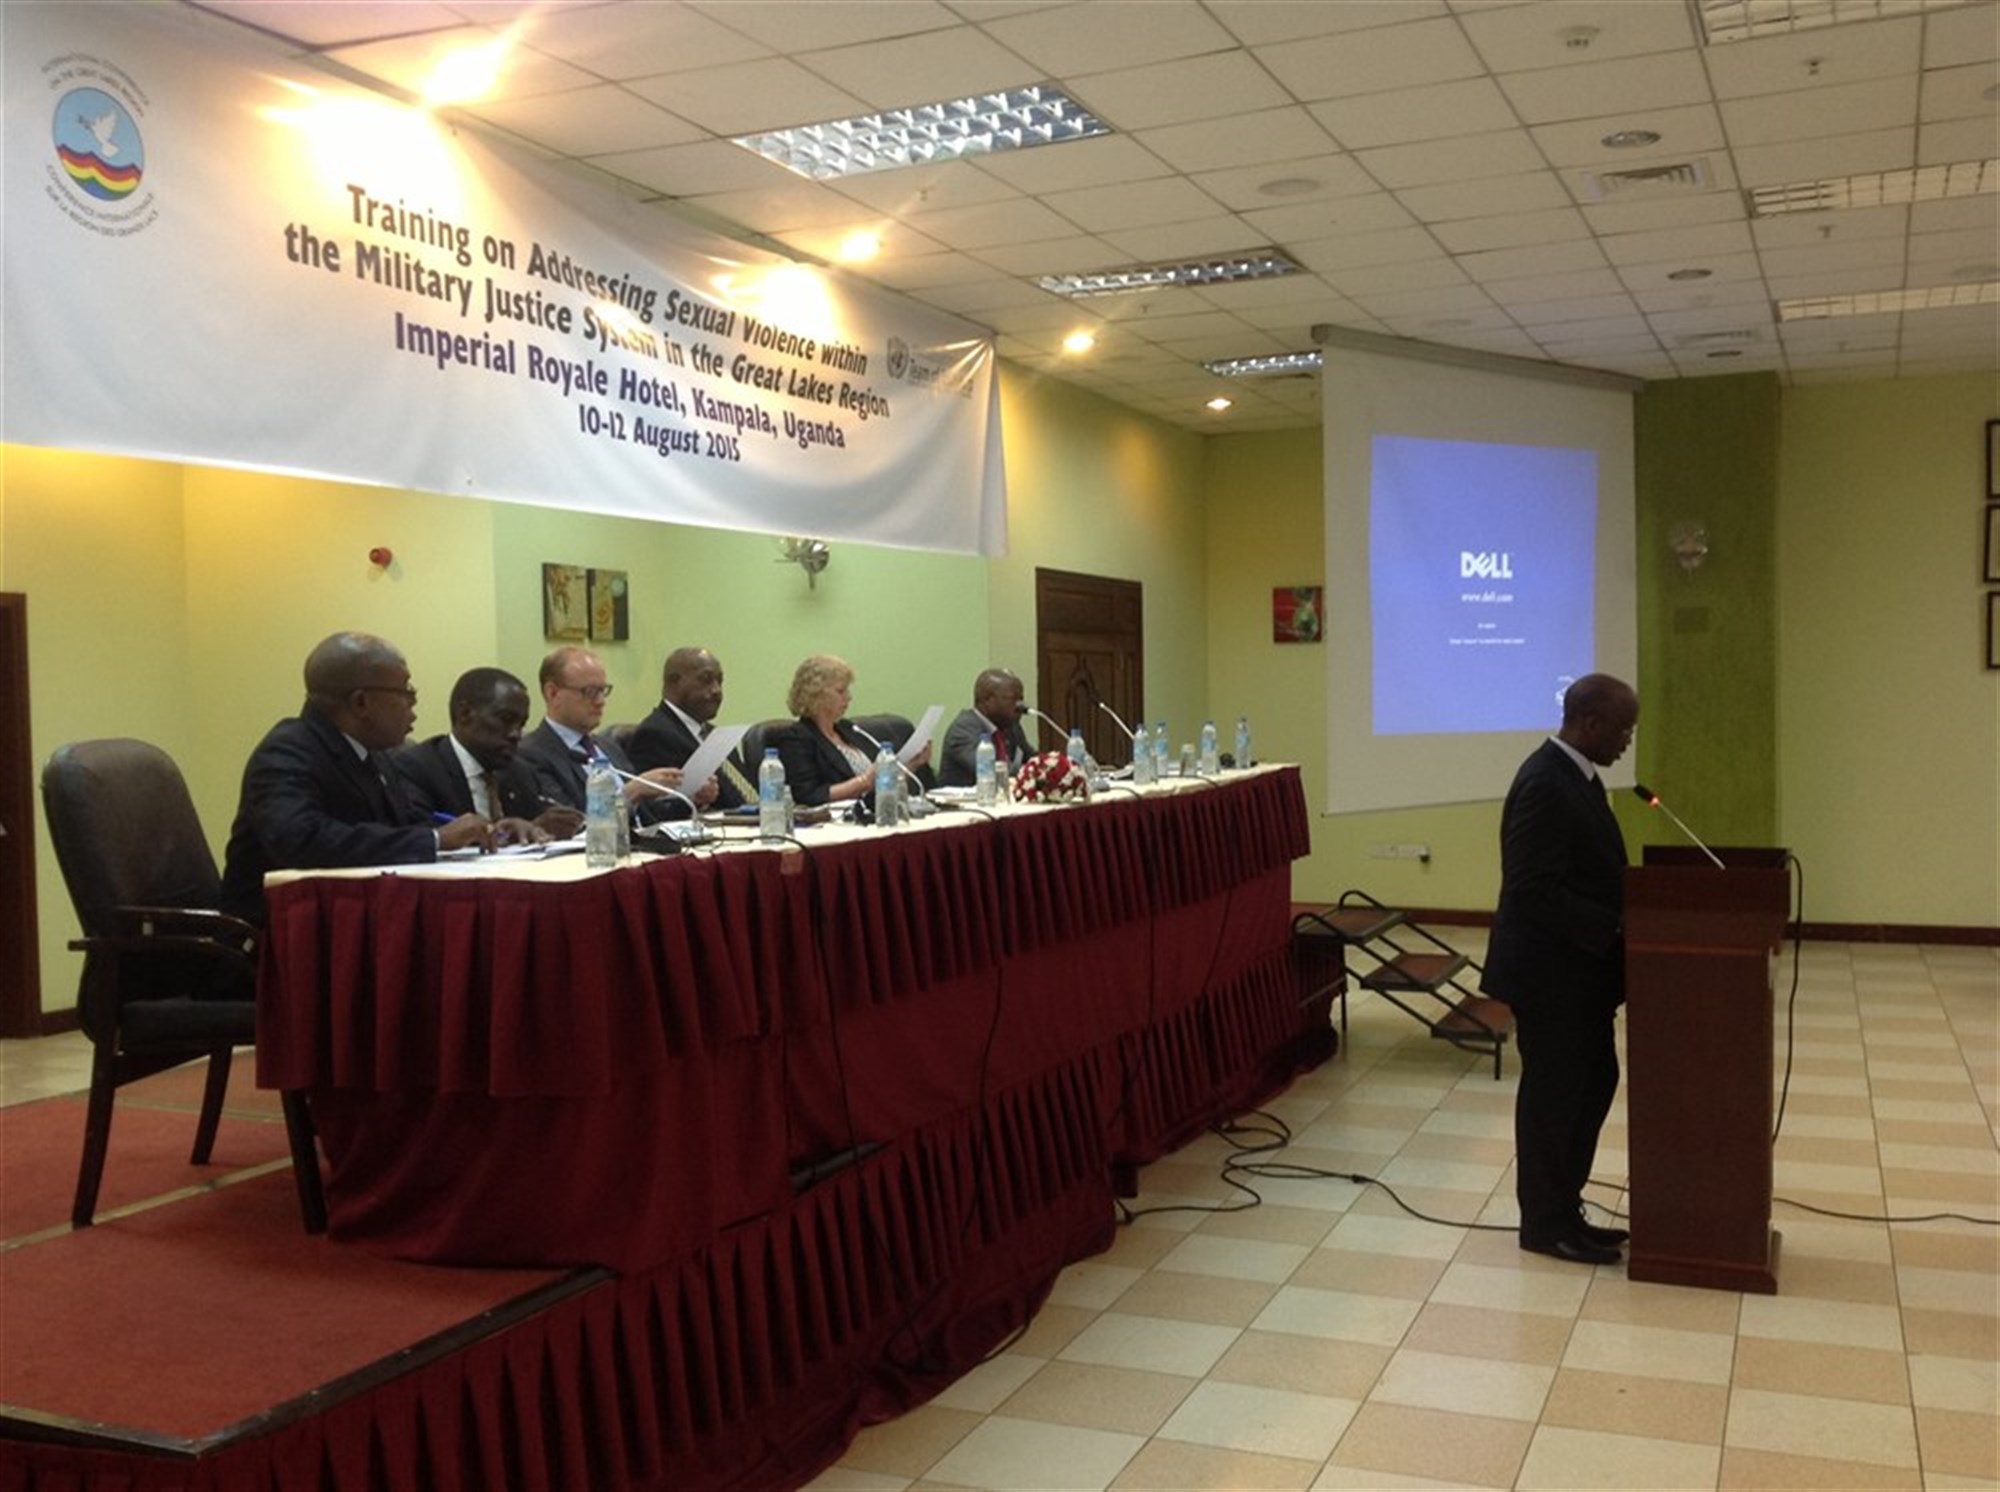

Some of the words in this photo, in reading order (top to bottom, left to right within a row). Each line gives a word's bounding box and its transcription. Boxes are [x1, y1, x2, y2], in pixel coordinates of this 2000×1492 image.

[284, 223, 340, 272] the
[355, 240, 472, 317] Military
[484, 277, 572, 333] Justice
[664, 332, 685, 367] in
[690, 343, 723, 377] the
[731, 354, 783, 392] Great
[788, 374, 834, 406] Lakes
[838, 386, 890, 420] Region
[347, 183, 472, 266] Training
[483, 235, 515, 270] on
[527, 243, 657, 324] Addressing
[664, 289, 736, 338] Sexual
[743, 316, 815, 361] Violence
[820, 341, 868, 376] within
[395, 312, 515, 374] Imperial
[528, 344, 608, 397] Royale
[619, 367, 687, 418] Hotel,
[692, 387, 777, 439] Kampala,
[784, 411, 846, 449] Uganda
[579, 404, 626, 441] 10-12
[633, 416, 699, 457] August
[706, 431, 740, 462] 2015
[1461, 551, 1513, 578] DELL
